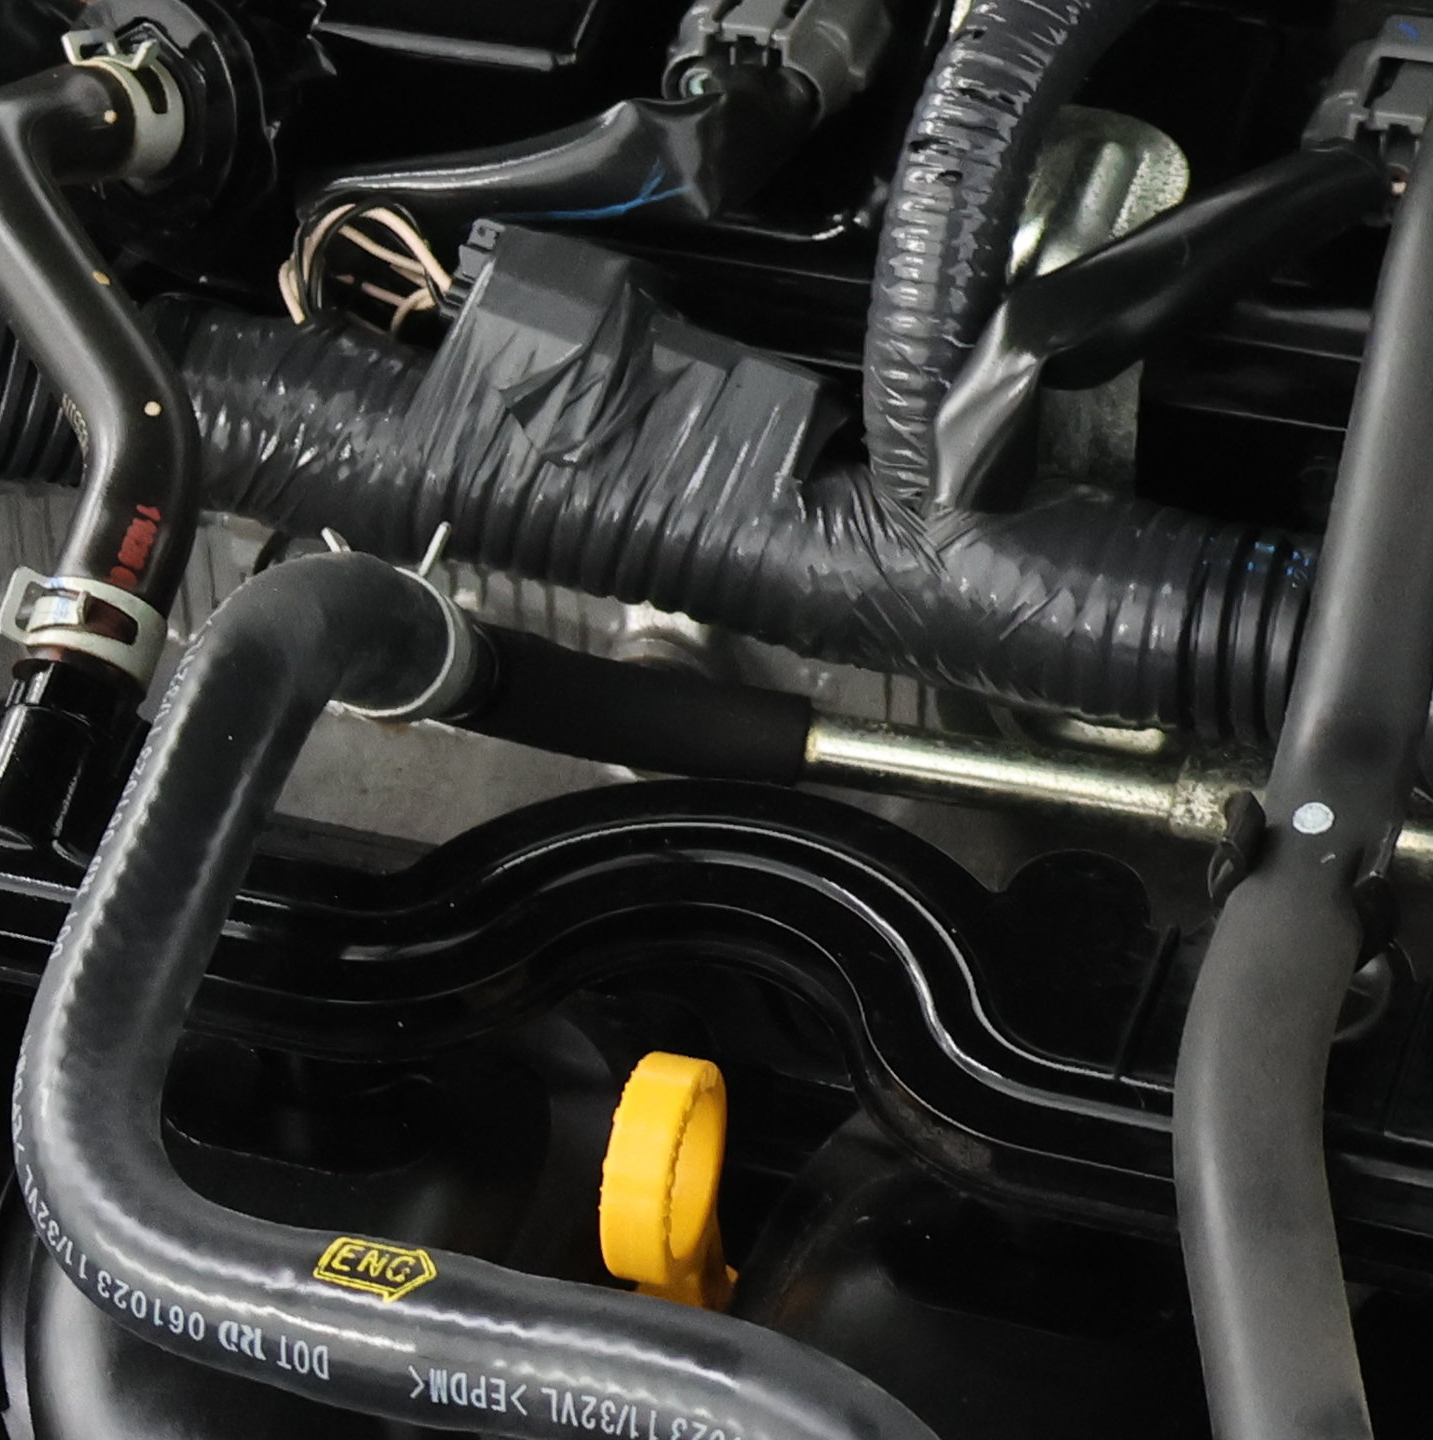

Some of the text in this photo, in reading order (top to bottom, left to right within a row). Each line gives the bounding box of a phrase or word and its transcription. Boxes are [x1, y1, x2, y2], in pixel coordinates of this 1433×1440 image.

[328, 1242, 419, 1285] ENG
[95, 1269, 206, 1342] 061023
[276, 1335, 330, 1382] DOT
